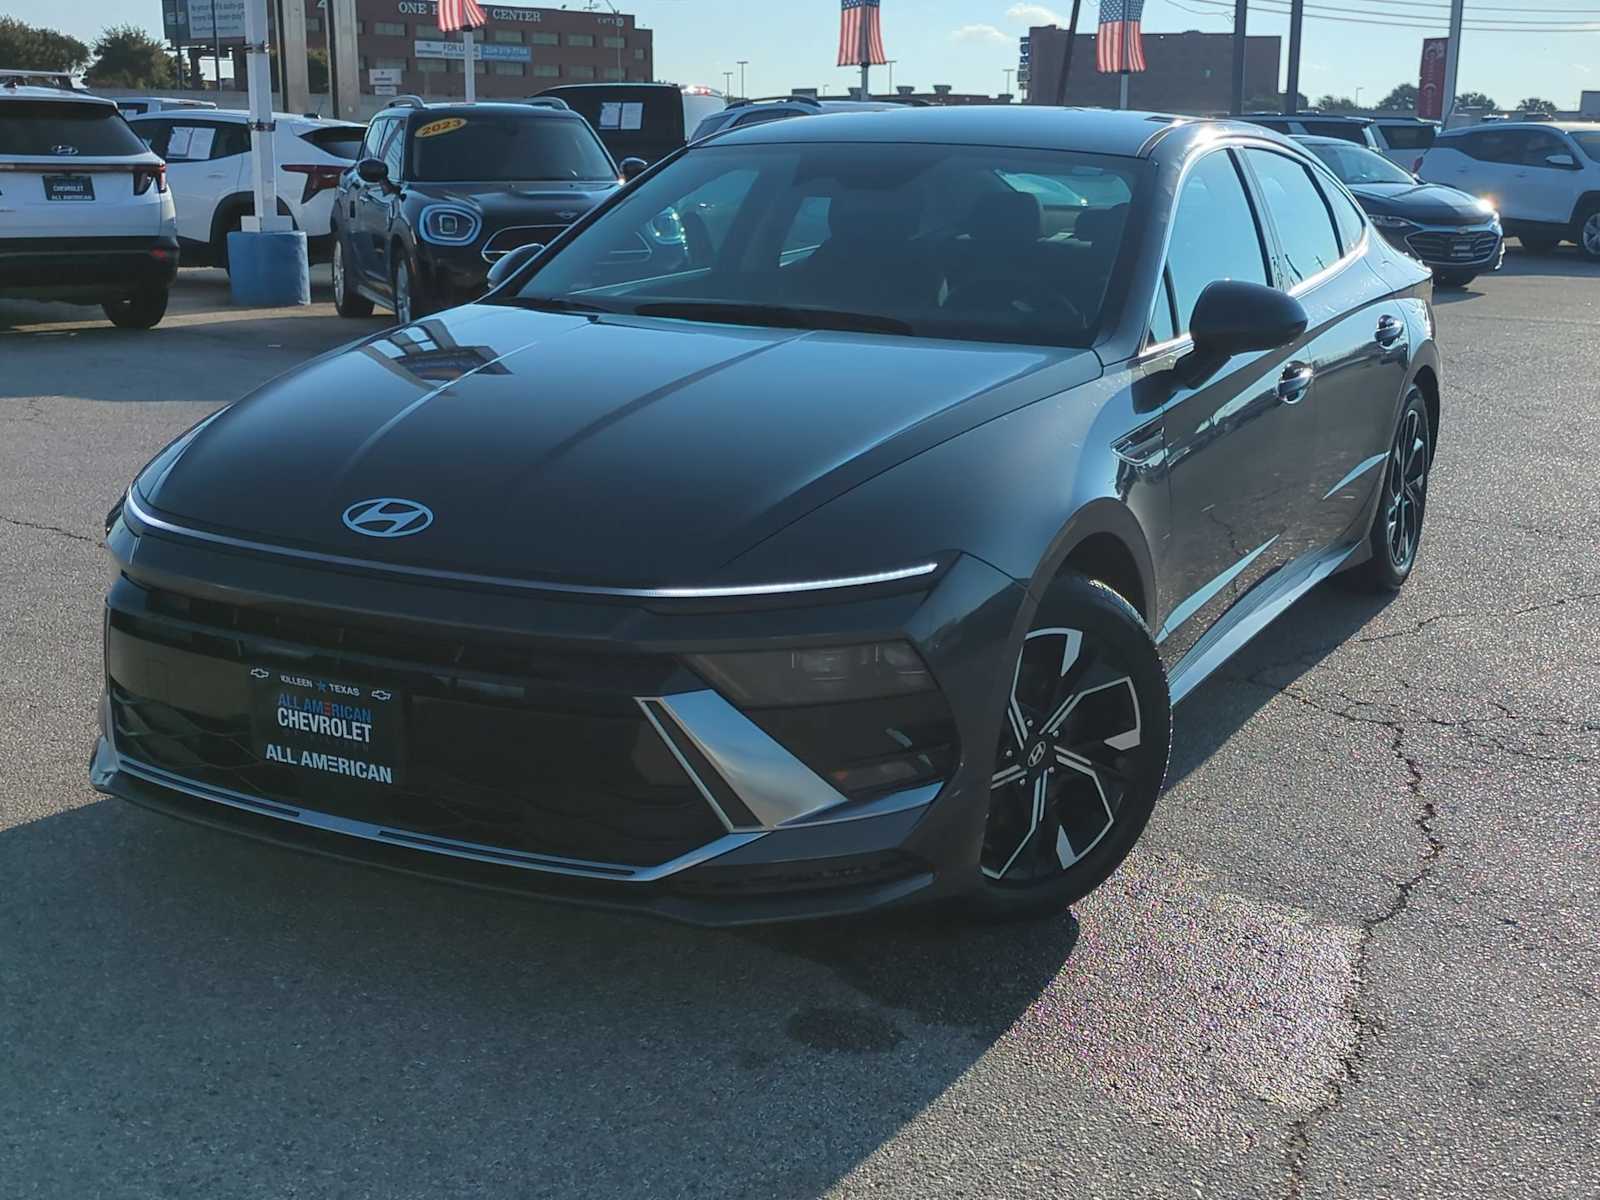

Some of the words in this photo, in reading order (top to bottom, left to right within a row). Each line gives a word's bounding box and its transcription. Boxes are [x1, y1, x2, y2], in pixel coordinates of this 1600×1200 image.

[398, 2, 427, 15] ONE
[492, 8, 542, 22] CENTER
[422, 118, 461, 135] 2023
[280, 675, 313, 688] KILLEEN
[329, 683, 361, 697] TEXAS
[278, 693, 300, 708] ALL
[303, 698, 372, 723] AMERICAN
[277, 707, 372, 744] CHEVROLET
[266, 743, 297, 765] ALL
[300, 751, 393, 785] AMERICAN
